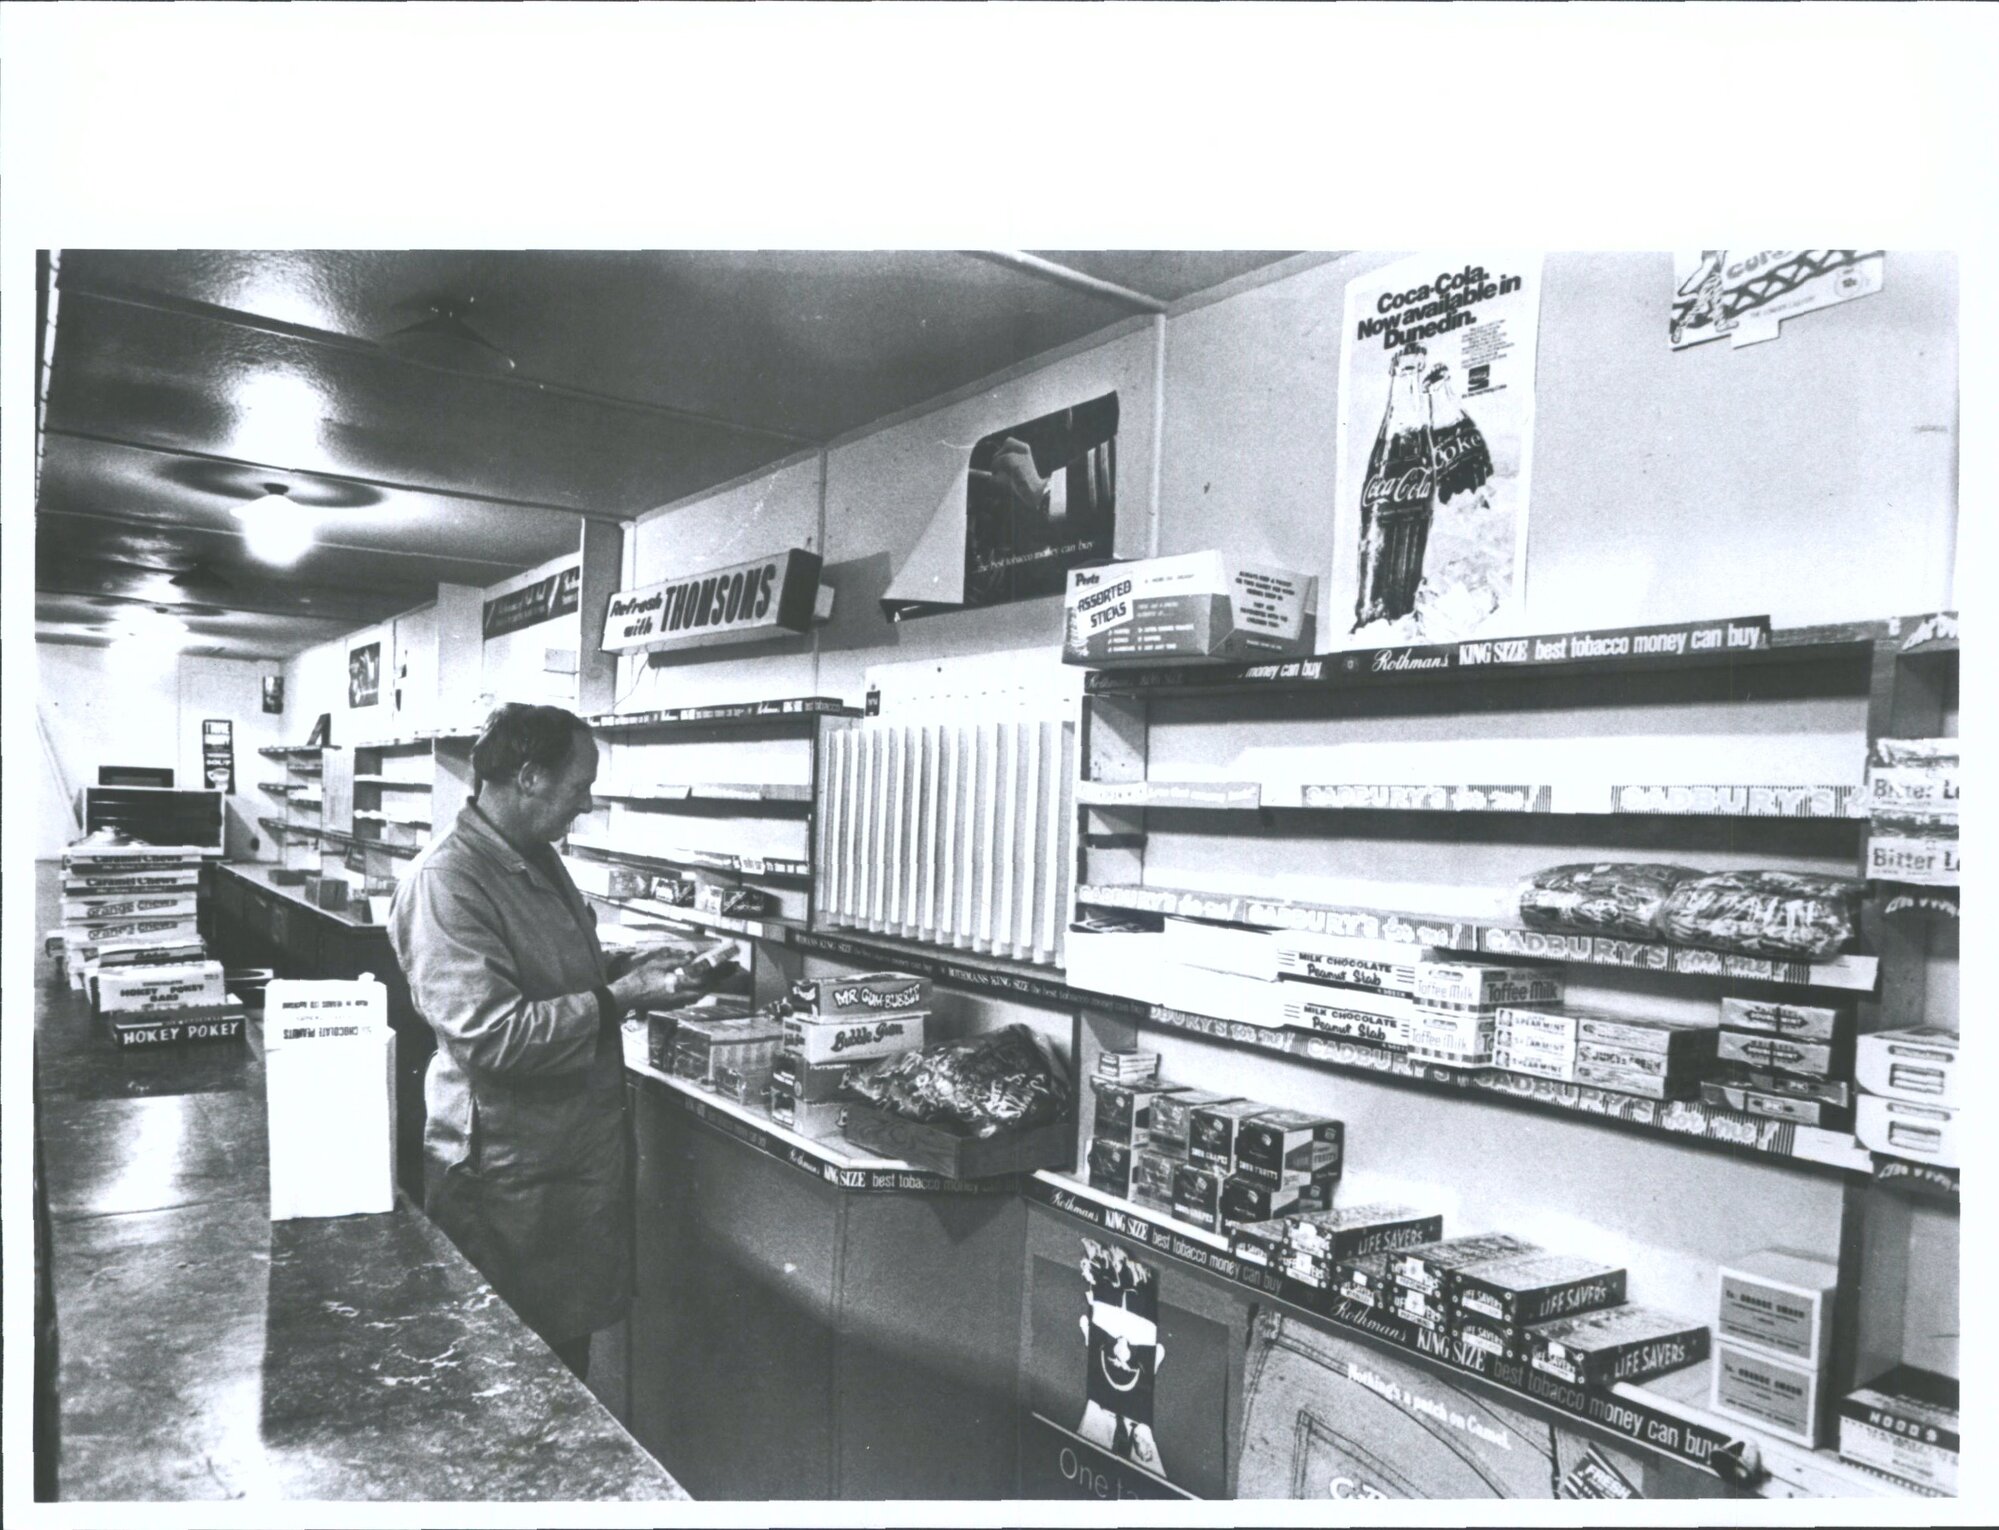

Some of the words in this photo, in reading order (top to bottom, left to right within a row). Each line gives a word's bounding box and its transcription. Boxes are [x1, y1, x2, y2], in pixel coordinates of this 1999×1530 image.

[1357, 313, 1401, 340] Now
[1402, 281, 1498, 326] available
[1500, 274, 1522, 295] in
[1383, 310, 1477, 350] Dunedin.
[610, 592, 663, 618] Refresh
[660, 563, 776, 632] THOMSONS
[1078, 579, 1132, 613] ASSORTED
[624, 617, 652, 638] with
[1090, 602, 1126, 628] STICKS
[1459, 643, 1491, 665] KING
[1494, 640, 1529, 663] SIZE
[1534, 638, 1567, 660] best
[1570, 635, 1629, 658] tobacco
[1633, 632, 1687, 654] money
[1691, 629, 1722, 649] can
[1727, 623, 1760, 649] buy
[1245, 665, 1278, 681] money
[1280, 662, 1299, 676] can
[1302, 659, 1322, 679] buy
[1621, 786, 1835, 816] CADBURY'S
[1873, 847, 1935, 869] Bitter
[1486, 929, 1668, 968] CADBURY'S
[1299, 952, 1322, 963] MILK
[1326, 957, 1392, 973] CHOCOLATE
[1307, 963, 1346, 981] Peanut
[1353, 970, 1381, 986] Slab
[120, 987, 158, 997] HOKEY
[170, 984, 204, 993] POKEY
[991, 974, 1012, 988] KING
[1013, 978, 1029, 990] SIZE
[1418, 980, 1447, 998] Toffee
[1450, 984, 1473, 1000] Milk
[1487, 982, 1529, 1002] Toffee
[1530, 981, 1557, 1000] Milk
[834, 988, 858, 1006] MR
[1304, 1006, 1327, 1016] MILK
[1331, 1011, 1397, 1028] CHOCOLATE
[1312, 1016, 1351, 1034] Peanut
[1358, 1023, 1386, 1041] Slab
[123, 1027, 179, 1044] HOKEY
[188, 1022, 239, 1038] POKEY
[319, 1026, 358, 1037] CHOCOLATE
[831, 1027, 872, 1052] Bubble
[873, 1022, 904, 1043] Gum
[1412, 1029, 1441, 1047] Toffee
[1443, 1033, 1467, 1050] Milk
[840, 1172, 866, 1187] SIZE
[872, 1173, 896, 1188] best
[899, 1174, 940, 1190] tobacco
[1104, 1208, 1126, 1232] KING
[1127, 1217, 1149, 1241] SIZE
[1152, 1228, 1170, 1250] best
[1172, 1234, 1207, 1265] tobacco
[1209, 1254, 1240, 1280] money
[1242, 1264, 1261, 1285] can
[1263, 1270, 1282, 1296] buy
[1358, 1234, 1381, 1255] LIFE
[1383, 1228, 1424, 1249] SAVERS
[1539, 1290, 1566, 1316] LIFE
[1567, 1284, 1607, 1309] SAVERS
[1614, 1353, 1639, 1378] LIFE
[1641, 1344, 1685, 1372] SAVERS
[1348, 1362, 1400, 1401] Nothing's
[1413, 1396, 1448, 1422] patch
[1450, 1412, 1466, 1430] on
[1417, 1328, 1450, 1359] KING
[1452, 1341, 1487, 1372] SIZE
[1494, 1360, 1524, 1387] best
[1528, 1367, 1585, 1411] tobacco
[1590, 1398, 1644, 1437] money
[1648, 1420, 1678, 1448] can
[1685, 1431, 1721, 1465] buy
[1059, 1447, 1108, 1499] One
